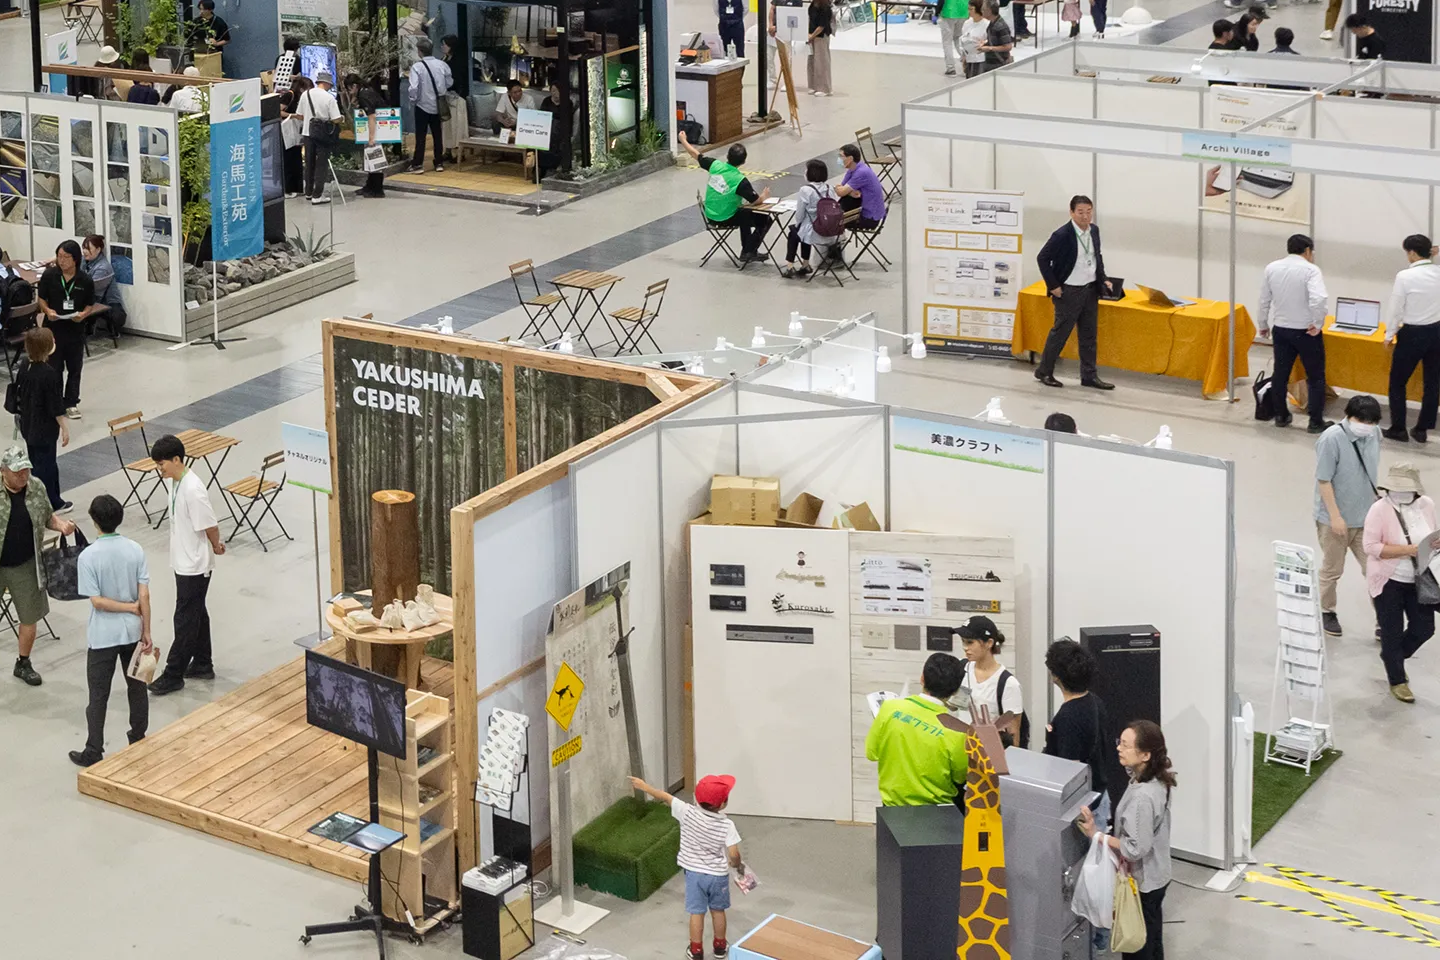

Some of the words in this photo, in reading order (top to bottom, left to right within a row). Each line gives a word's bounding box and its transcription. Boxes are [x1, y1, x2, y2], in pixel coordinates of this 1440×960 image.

[1201, 143, 1230, 153] Archi
[1232, 146, 1271, 158] Village
[229, 143, 248, 223] 海馬工苑
[220, 170, 230, 247] Garden&Exterior
[351, 358, 486, 401] YAKUSHIMA
[352, 385, 424, 418] CEDER
[930, 432, 1004, 454] 美濃クラフト
[950, 572, 984, 581] TSUCHIYA
[891, 710, 945, 737] 美濃クラフト
[554, 742, 580, 761] CAUTION
